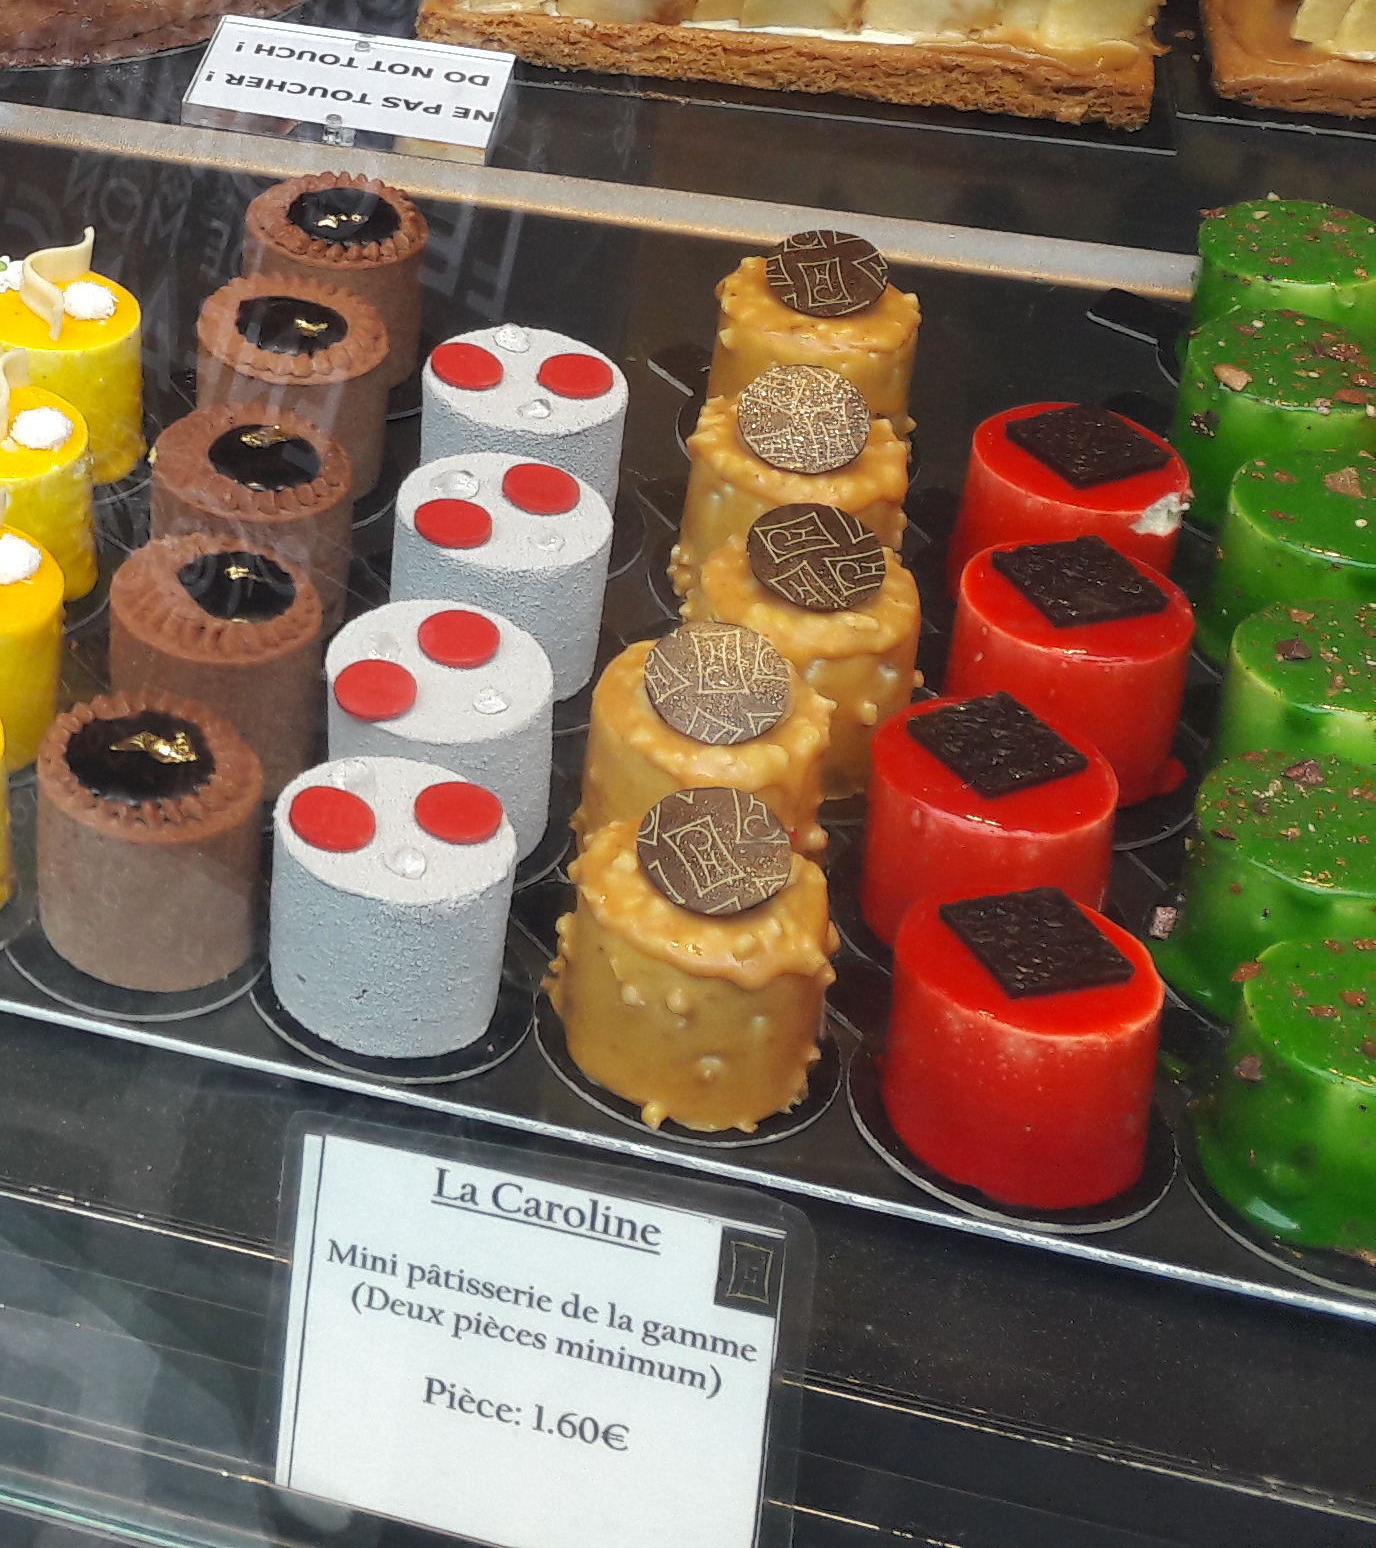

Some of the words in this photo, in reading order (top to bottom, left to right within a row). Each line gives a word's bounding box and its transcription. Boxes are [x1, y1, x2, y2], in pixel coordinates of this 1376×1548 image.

[253, 43, 359, 69] TOUCH
[366, 58, 435, 79] NOT
[225, 72, 373, 105] TOUCHER
[444, 71, 490, 87] DO
[382, 97, 442, 115] PAS
[452, 106, 495, 124] NE
[434, 1168, 478, 1206] La
[492, 1183, 660, 1245] Caroline
[328, 1240, 397, 1275] Mini
[407, 1264, 551, 1312] pâtisserie
[561, 1294, 598, 1323] de
[608, 1302, 633, 1332] la
[642, 1321, 756, 1361] gamme
[352, 1282, 444, 1326] (Deux
[452, 1313, 546, 1349] pièces
[557, 1338, 721, 1398] minimum)
[424, 1377, 520, 1424] Pièce:
[533, 1405, 629, 1451] 1.60€
